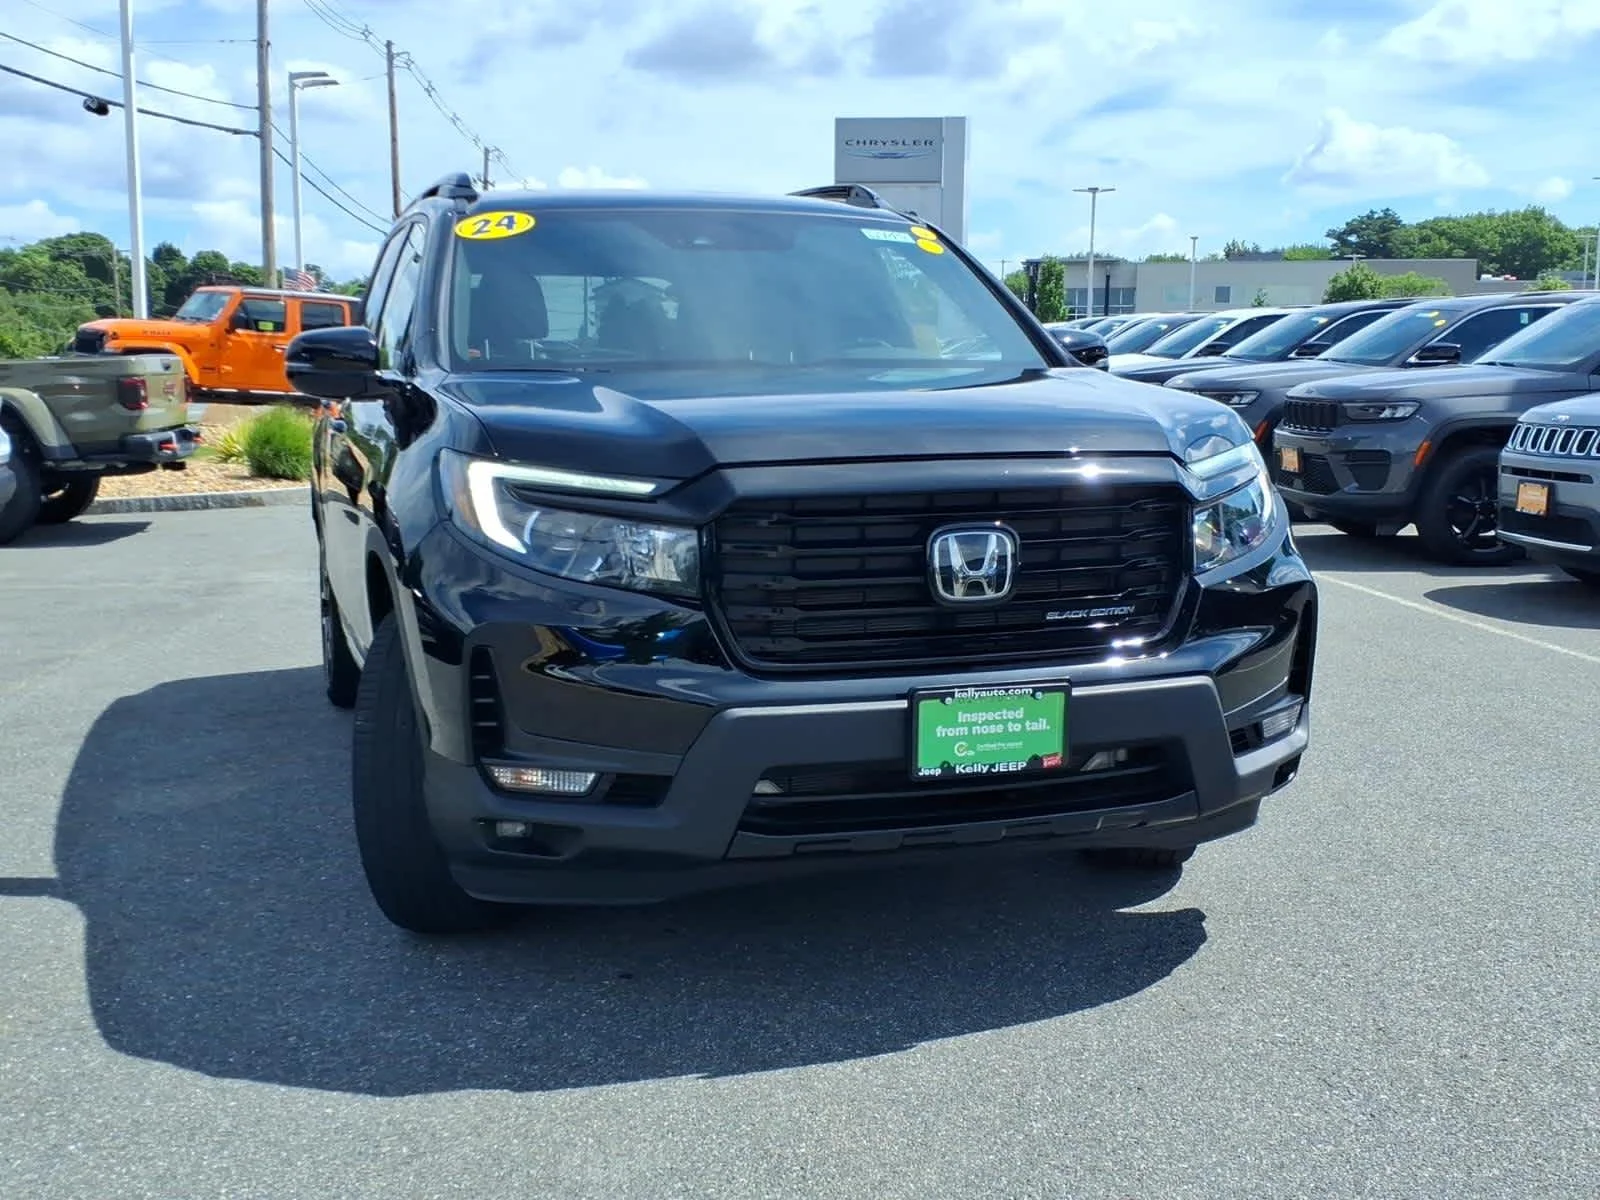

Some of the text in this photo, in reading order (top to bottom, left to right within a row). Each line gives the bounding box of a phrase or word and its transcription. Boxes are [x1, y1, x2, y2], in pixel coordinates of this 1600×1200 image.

[844, 139, 935, 147] CHRYSLER
[471, 215, 517, 236] 24
[1046, 605, 1135, 620] BLACK EDITION
[954, 687, 1033, 700] kellyauto.com
[957, 708, 1024, 724] Inspected
[936, 718, 1051, 738] from nose to tail.
[918, 767, 942, 777] Jeep
[955, 761, 1027, 775] Kelly JEEP
